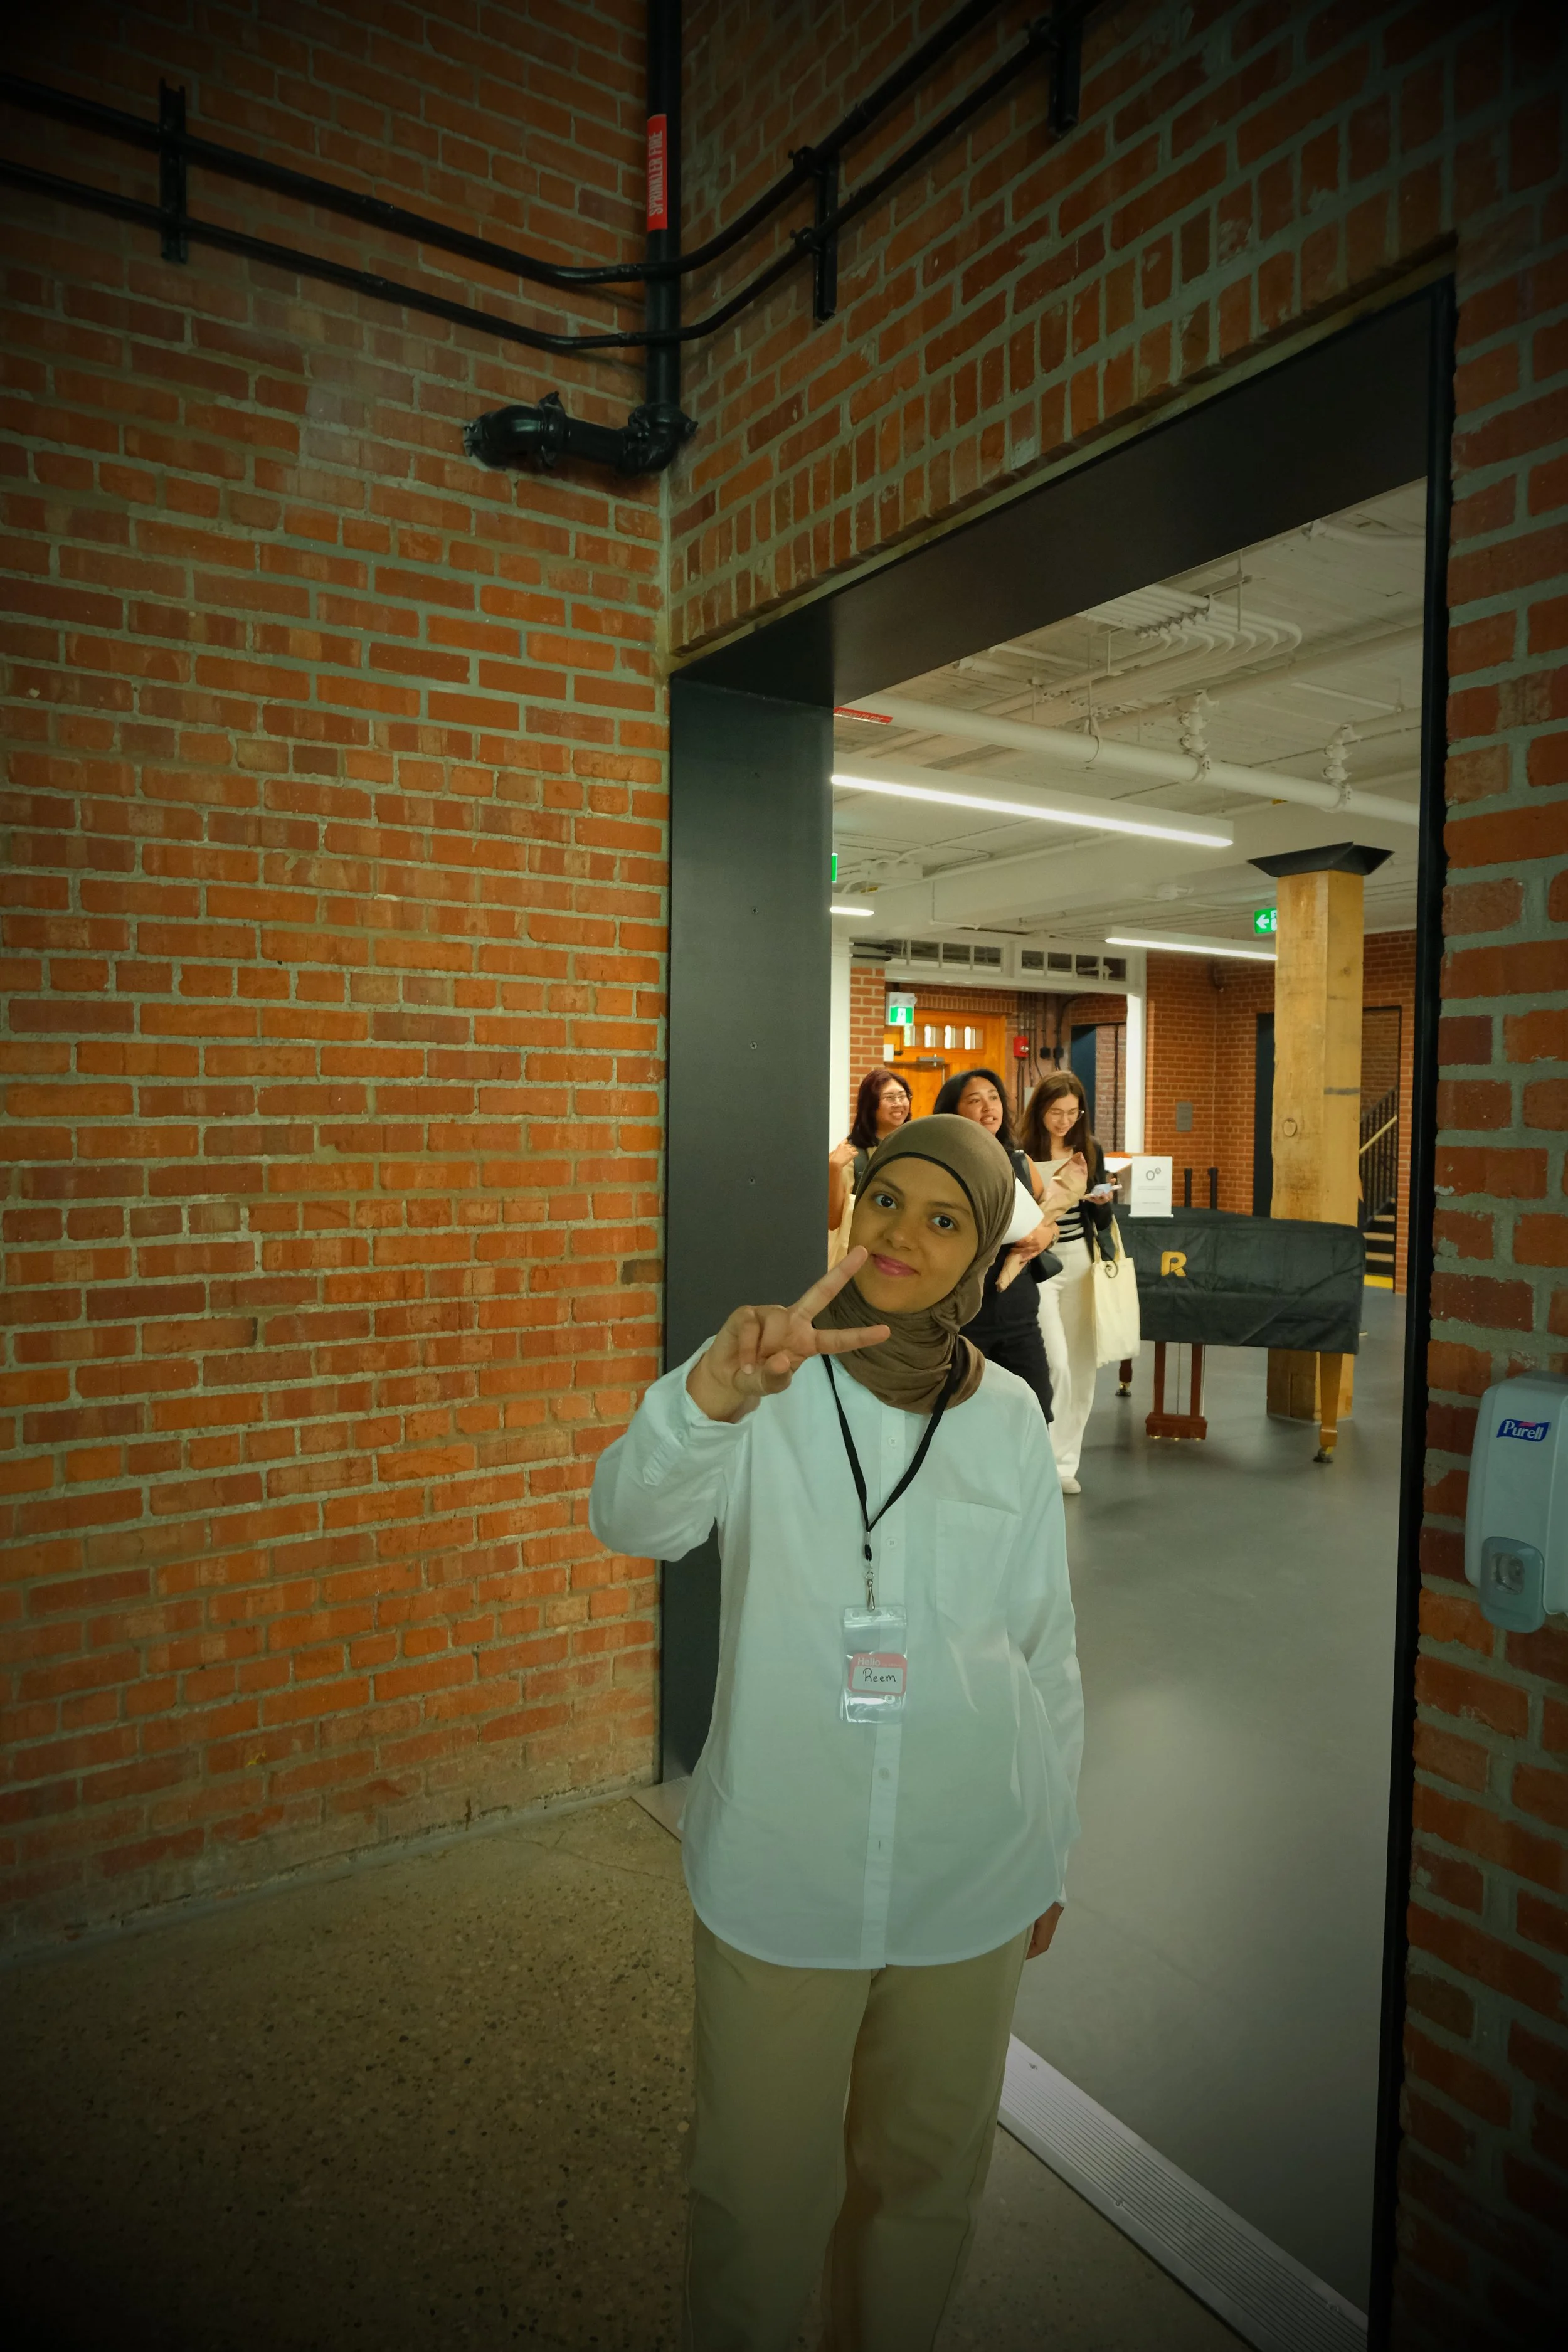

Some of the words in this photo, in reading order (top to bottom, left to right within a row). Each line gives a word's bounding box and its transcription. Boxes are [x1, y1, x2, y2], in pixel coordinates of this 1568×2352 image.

[649, 130, 663, 156] FIRE
[649, 157, 664, 216] SPRINKLER
[1161, 1251, 1187, 1277] R
[1503, 1420, 1544, 1440] Purell
[857, 1656, 881, 1666] Hello
[863, 1668, 896, 1682] Reem
